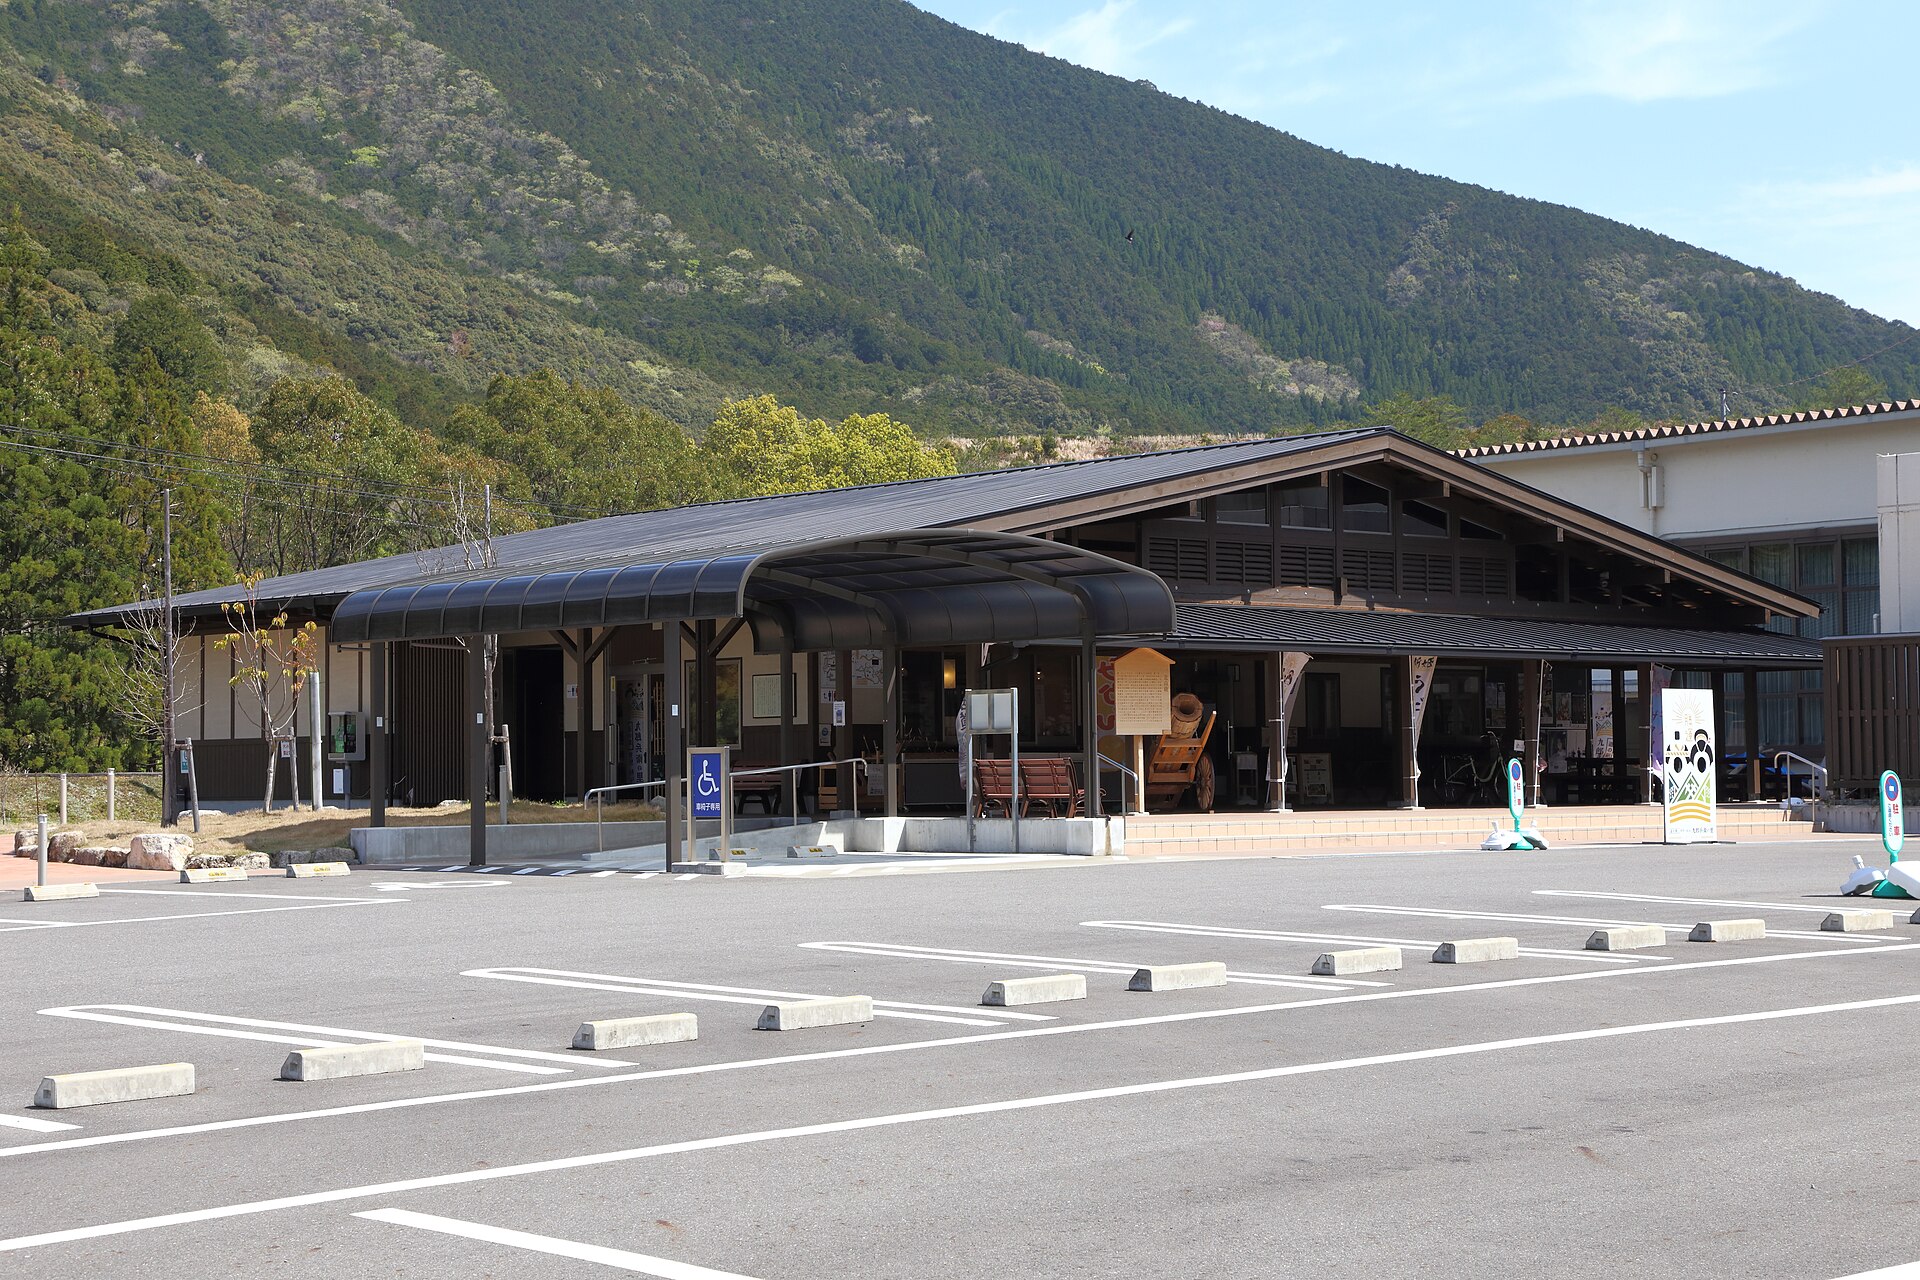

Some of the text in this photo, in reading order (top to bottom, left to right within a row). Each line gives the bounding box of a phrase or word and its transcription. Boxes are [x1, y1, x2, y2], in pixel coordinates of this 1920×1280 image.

[695, 802, 721, 811] 車椅子専用
